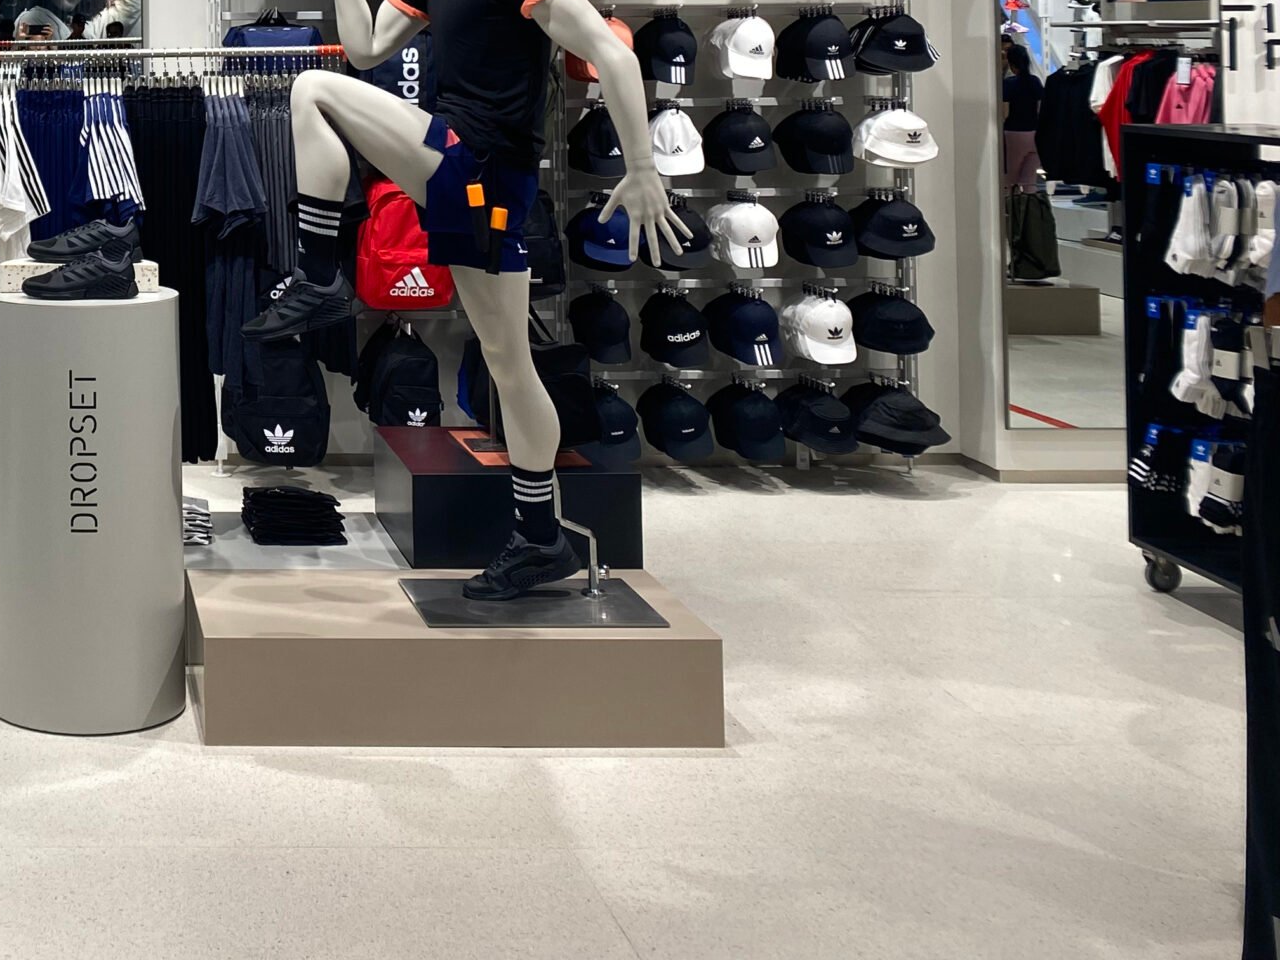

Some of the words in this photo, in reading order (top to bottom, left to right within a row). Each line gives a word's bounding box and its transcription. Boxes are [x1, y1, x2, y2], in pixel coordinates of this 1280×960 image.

[397, 87, 420, 105] idas
[389, 286, 435, 297] adidas
[666, 329, 702, 344] adidas
[69, 369, 98, 533] DROPSET
[264, 445, 296, 454] adidas
